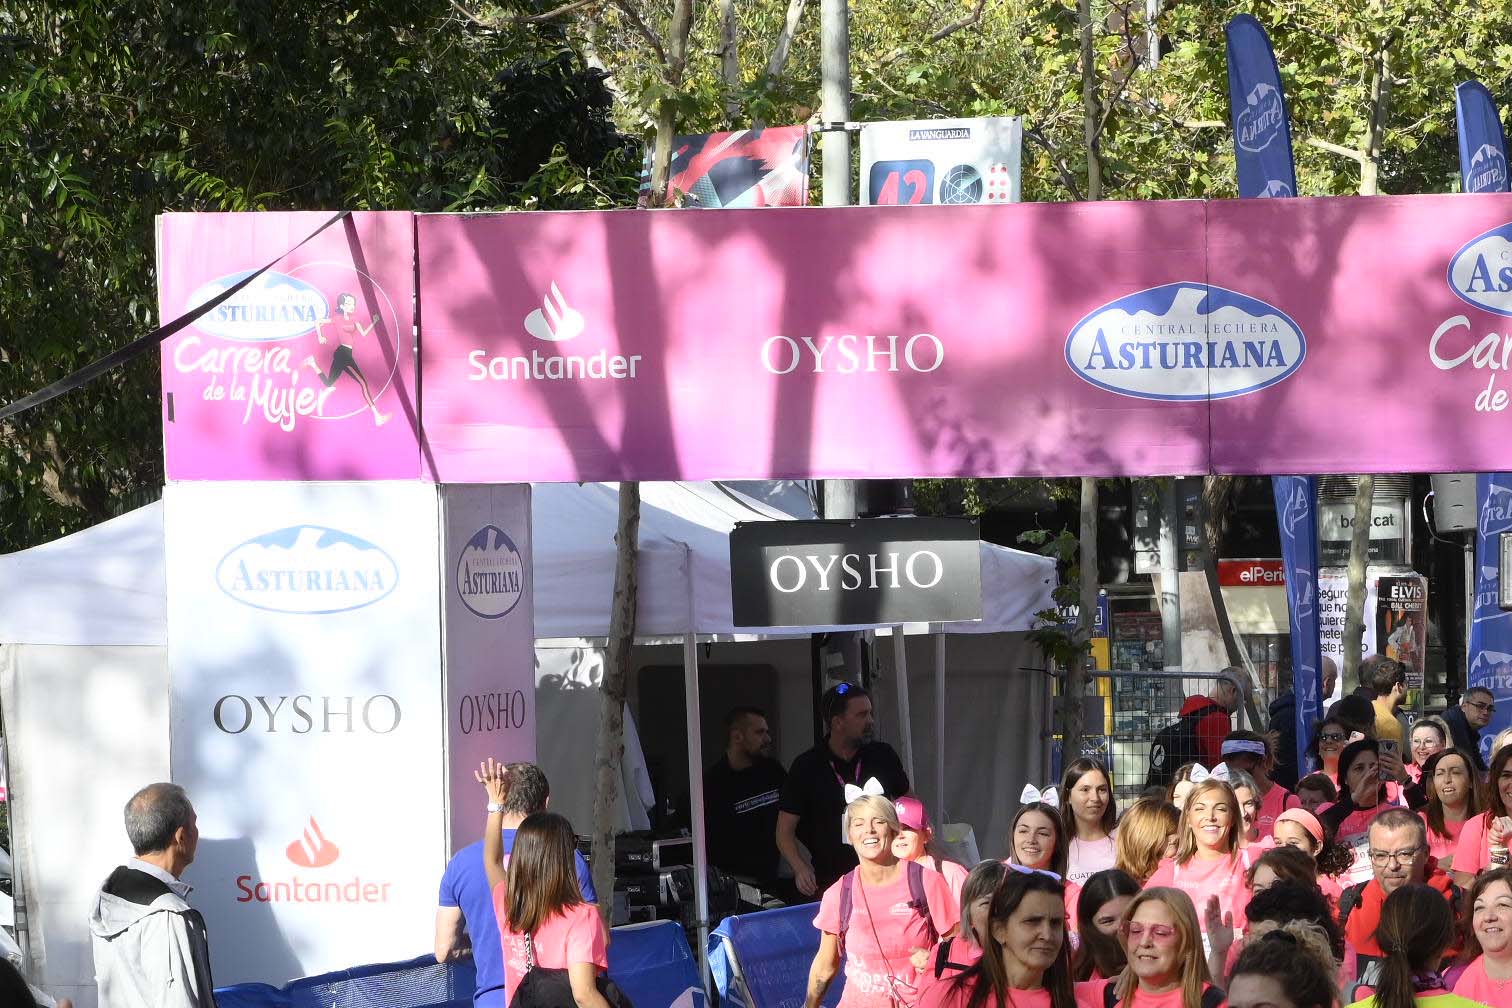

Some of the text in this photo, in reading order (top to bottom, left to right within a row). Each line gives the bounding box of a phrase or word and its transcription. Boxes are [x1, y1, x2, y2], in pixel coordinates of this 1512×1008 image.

[1121, 321, 1280, 336] CENTRAL LECHERA
[173, 335, 293, 374] Carrera
[468, 348, 642, 381] Santander
[760, 333, 945, 375] OYSHO
[1084, 327, 1288, 371] ASTURIANA
[203, 370, 337, 432] de la Mujer
[1475, 375, 1509, 412] de
[232, 559, 385, 592] ASTURIANA
[463, 561, 520, 595] ASTURIANA
[769, 550, 944, 594] OYSHO
[1391, 585, 1422, 598] ELVIS
[213, 694, 402, 734] OYSHO
[459, 689, 525, 734] OYSHO
[236, 874, 392, 903] Santander
